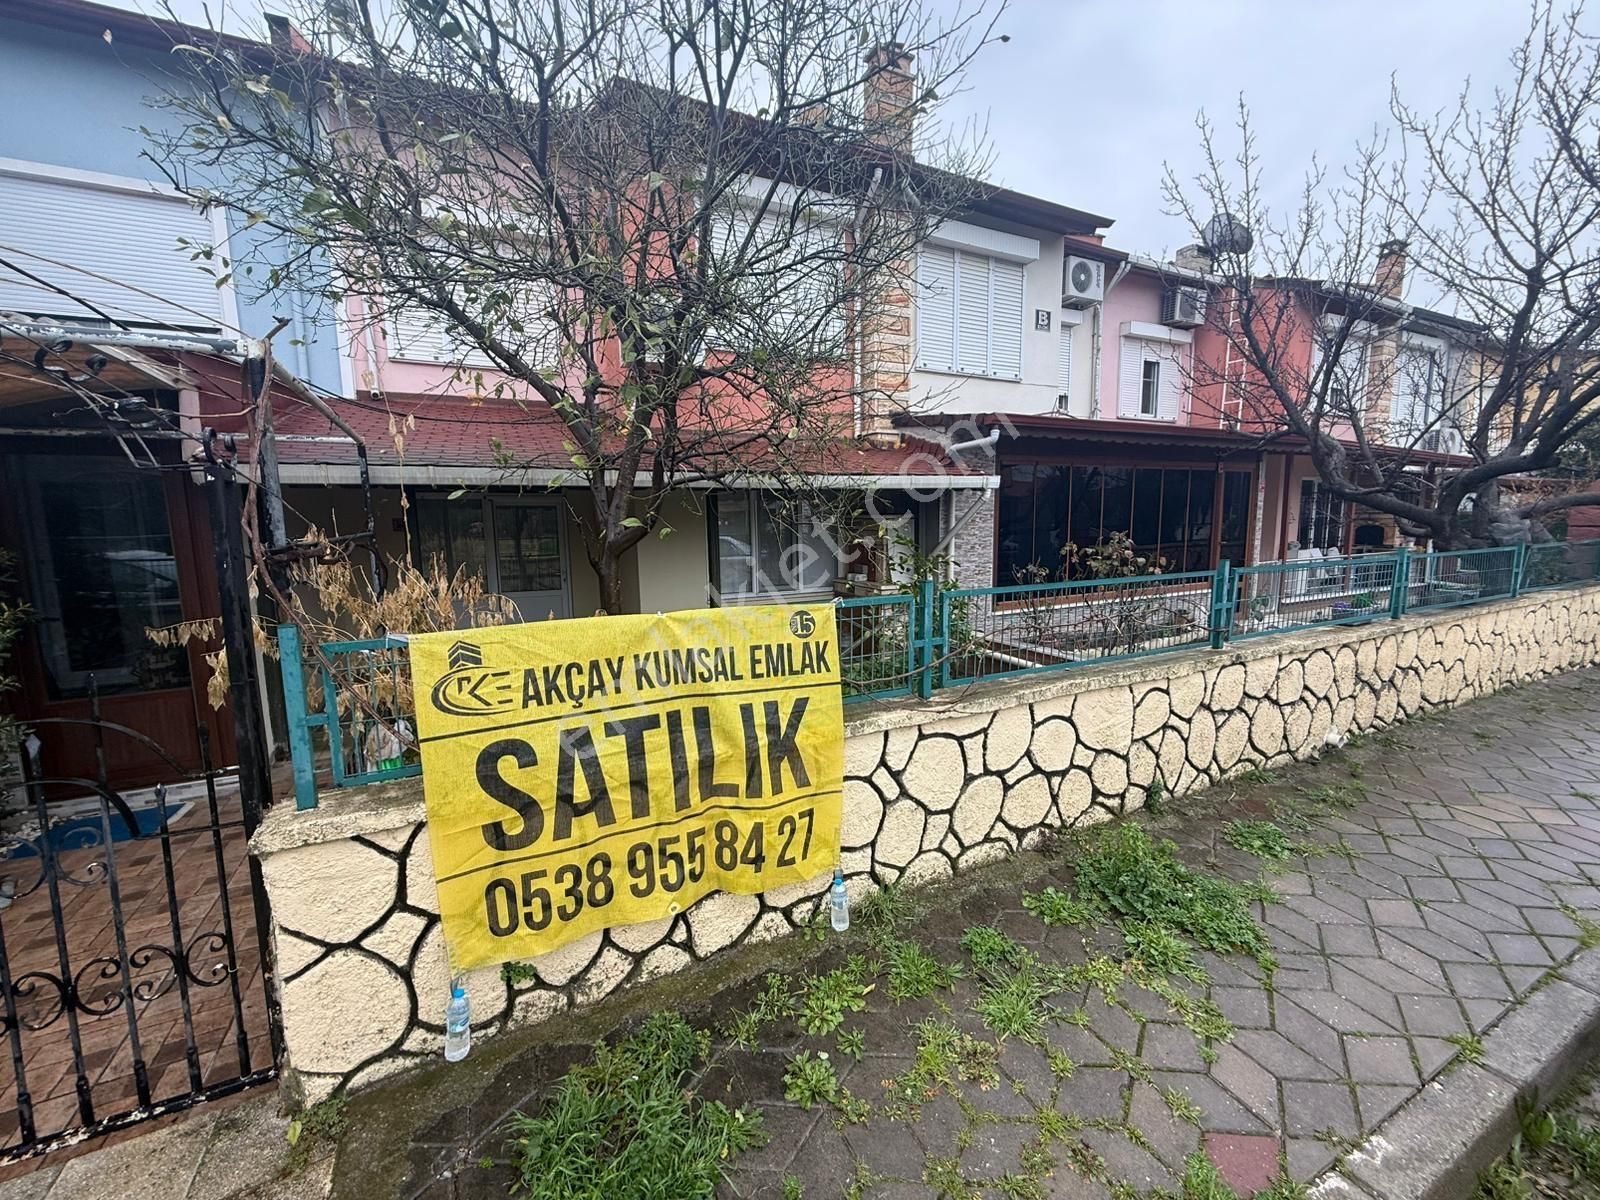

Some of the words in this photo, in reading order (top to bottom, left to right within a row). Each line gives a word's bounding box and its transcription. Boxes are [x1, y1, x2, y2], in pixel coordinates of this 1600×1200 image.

[1038, 311, 1049, 326] B
[794, 614, 815, 635] 15
[521, 655, 625, 709] AKÇAY
[633, 646, 742, 690] KUMSAL
[750, 640, 831, 680] EMLAK
[475, 697, 811, 851] SATILIK
[484, 853, 614, 938] 0538
[627, 826, 707, 898] 955
[713, 819, 766, 874] 84
[776, 808, 815, 867] 27
